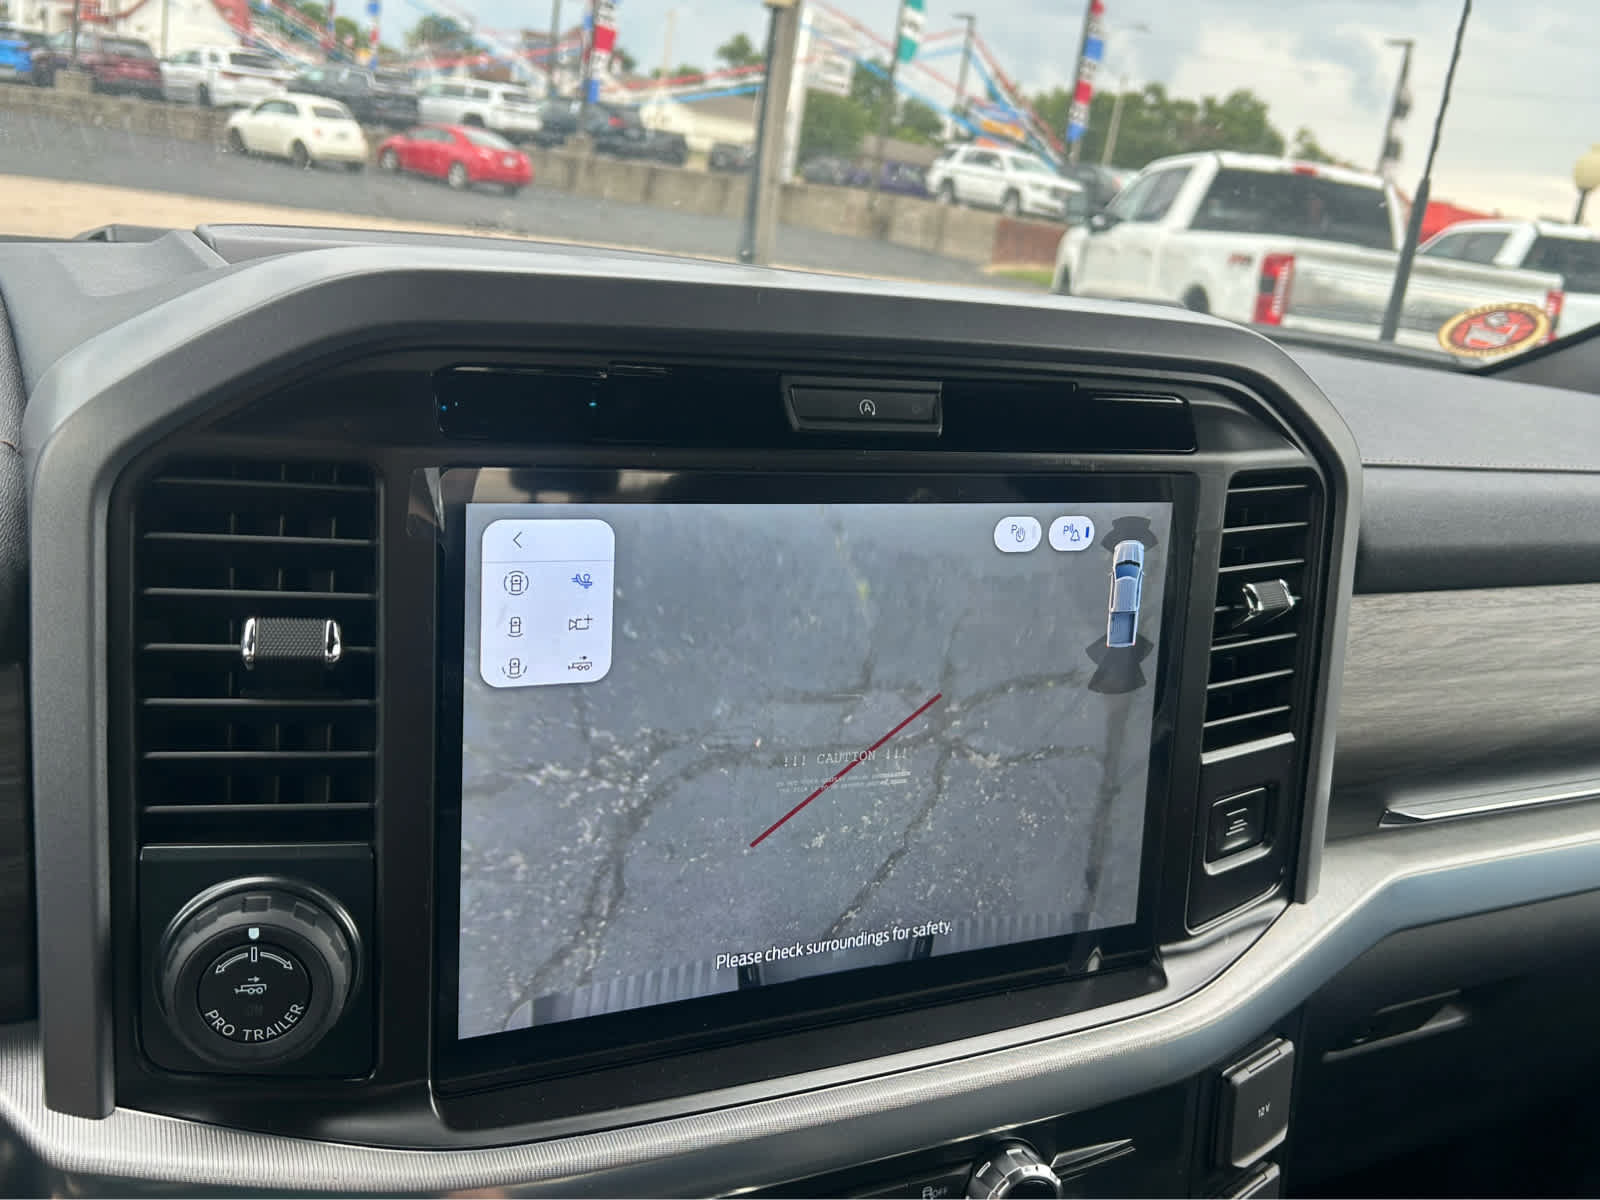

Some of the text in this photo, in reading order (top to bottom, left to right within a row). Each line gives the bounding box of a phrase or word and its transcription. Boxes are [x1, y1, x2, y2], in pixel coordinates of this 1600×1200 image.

[816, 750, 876, 765] CAUTION
[716, 919, 953, 969] Please check surroundings for safety.
[205, 1003, 304, 1041] PRO TRAILER
